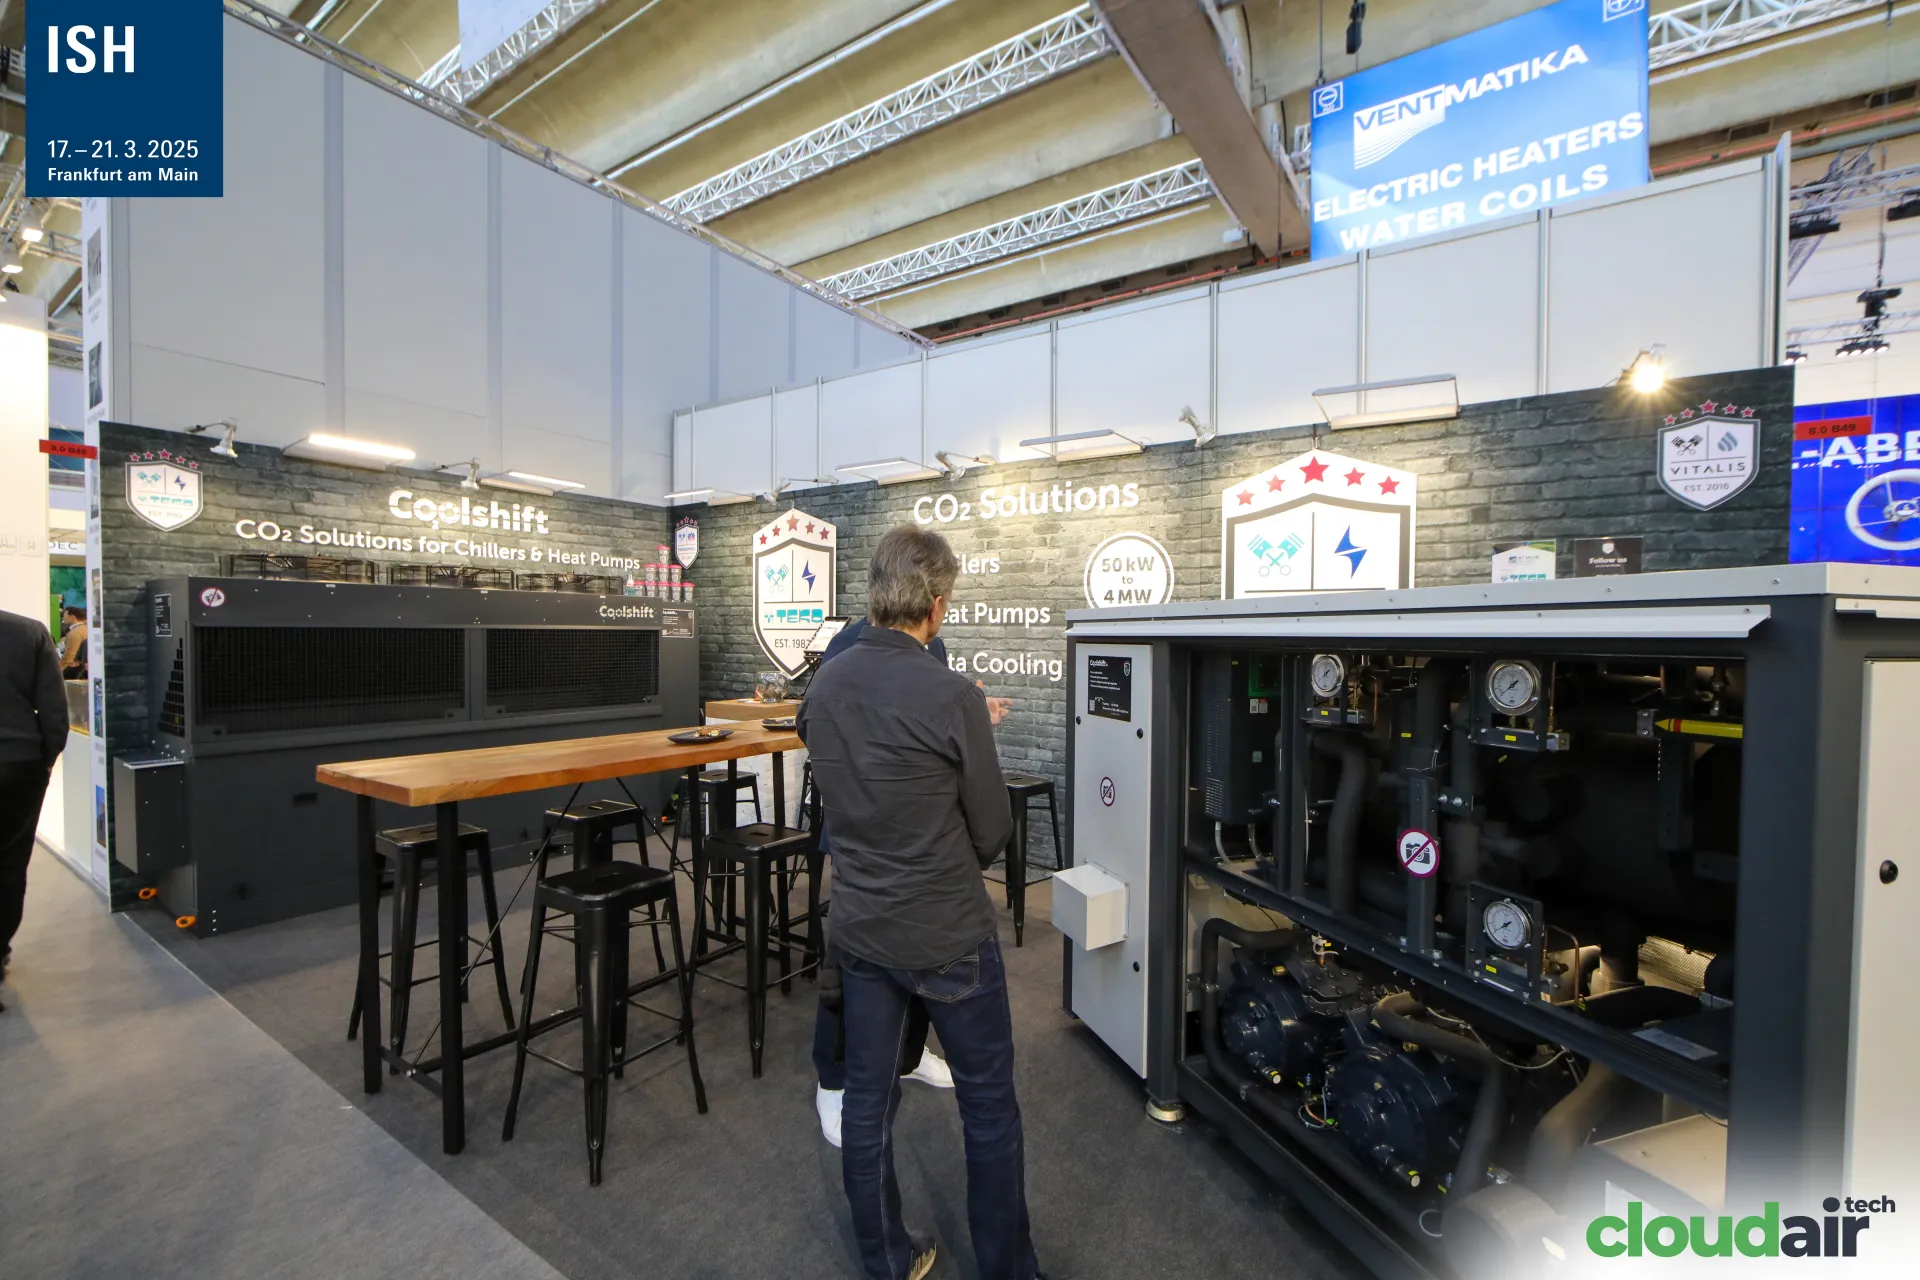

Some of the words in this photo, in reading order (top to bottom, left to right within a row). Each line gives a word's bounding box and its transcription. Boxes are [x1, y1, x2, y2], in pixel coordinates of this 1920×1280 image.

[1356, 44, 1589, 131] VENTMATIKA
[1314, 163, 1463, 222] ELECTRIC
[1473, 112, 1644, 181] HEATERS
[1340, 201, 1465, 250] WATER
[1479, 164, 1609, 209] COILS
[1832, 423, 1856, 433] B49
[1670, 462, 1746, 476] VITALIS
[980, 481, 1139, 520] Solutions
[300, 525, 413, 551] Solutions
[418, 535, 449, 554] for
[454, 539, 526, 561] Chillers
[531, 545, 543, 562] &
[549, 549, 586, 566] Heat
[591, 552, 640, 571] Pumps
[1102, 557, 1122, 573] 50
[1127, 556, 1155, 572] kW
[1122, 576, 1134, 584] to
[1104, 589, 1114, 604] 4
[1119, 588, 1153, 604] MW
[975, 602, 1051, 628] Pumps
[774, 638, 791, 649] EST.
[973, 652, 1063, 682] Cooling
